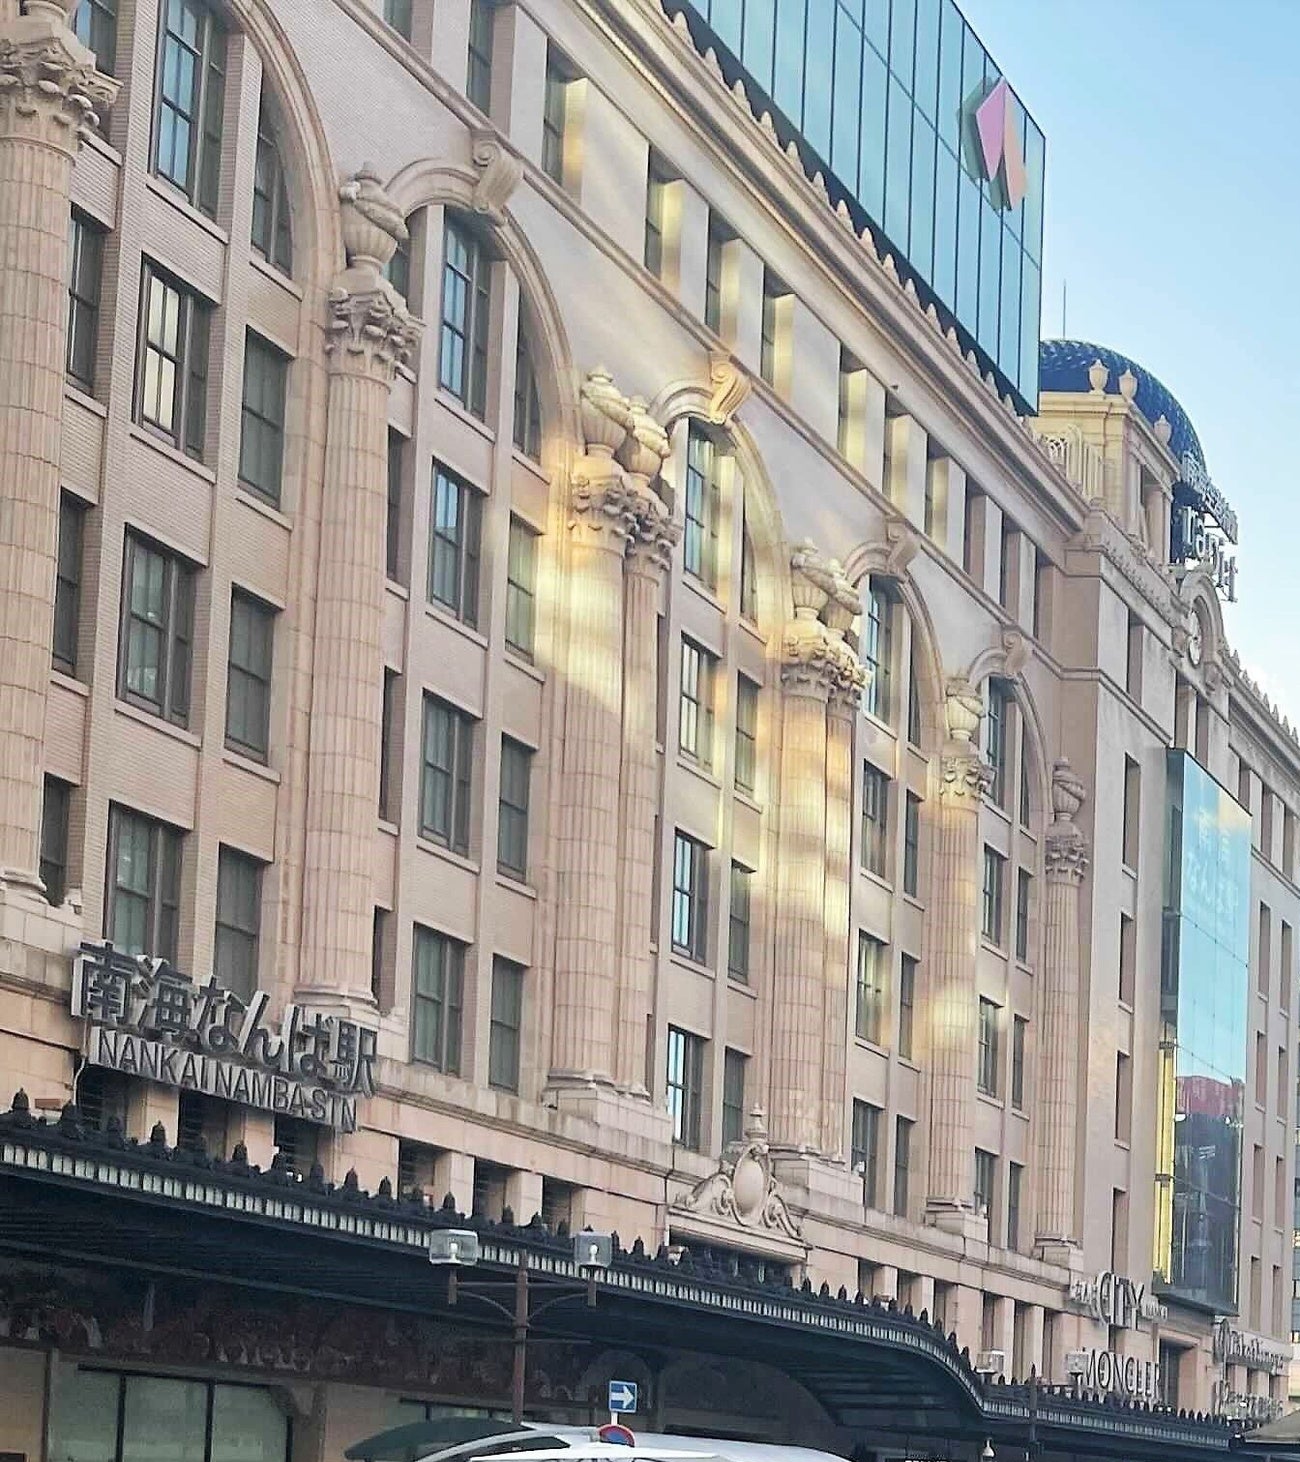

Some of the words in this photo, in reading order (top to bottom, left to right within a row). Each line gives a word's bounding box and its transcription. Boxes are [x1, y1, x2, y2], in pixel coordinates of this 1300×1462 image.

[71, 938, 378, 1099] 南海なんば駅
[91, 1026, 209, 1091] NANKAI
[208, 1056, 308, 1118] NAMBA
[1099, 1271, 1145, 1331] CITY
[1085, 1347, 1161, 1402] MONCLER
